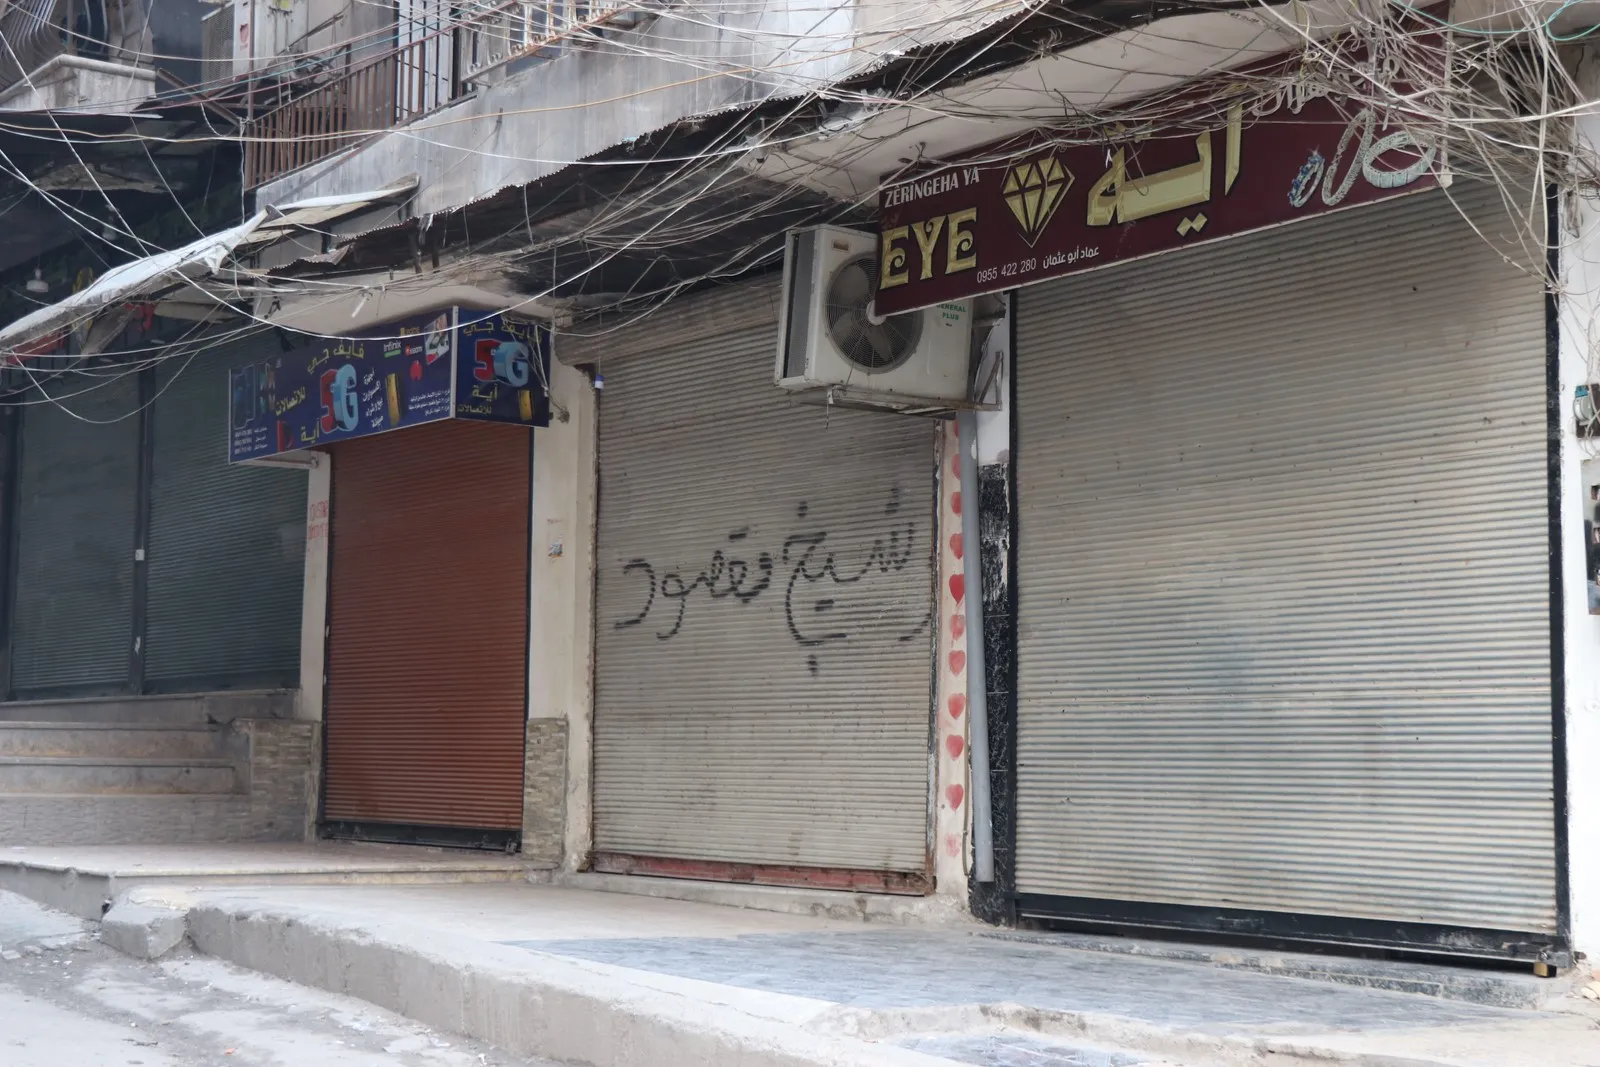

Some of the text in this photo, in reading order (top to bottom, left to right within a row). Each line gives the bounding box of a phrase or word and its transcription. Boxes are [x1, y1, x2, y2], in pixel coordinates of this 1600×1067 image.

[963, 166, 981, 186] YA
[879, 206, 978, 290] EYE
[1042, 245, 1100, 270] عماد أبو عثمان
[976, 257, 1038, 284] 0955 422 280
[307, 339, 365, 375] فايف جي
[473, 338, 529, 388] 5G
[275, 385, 306, 416] للاتصالات
[320, 363, 359, 434] 5G
